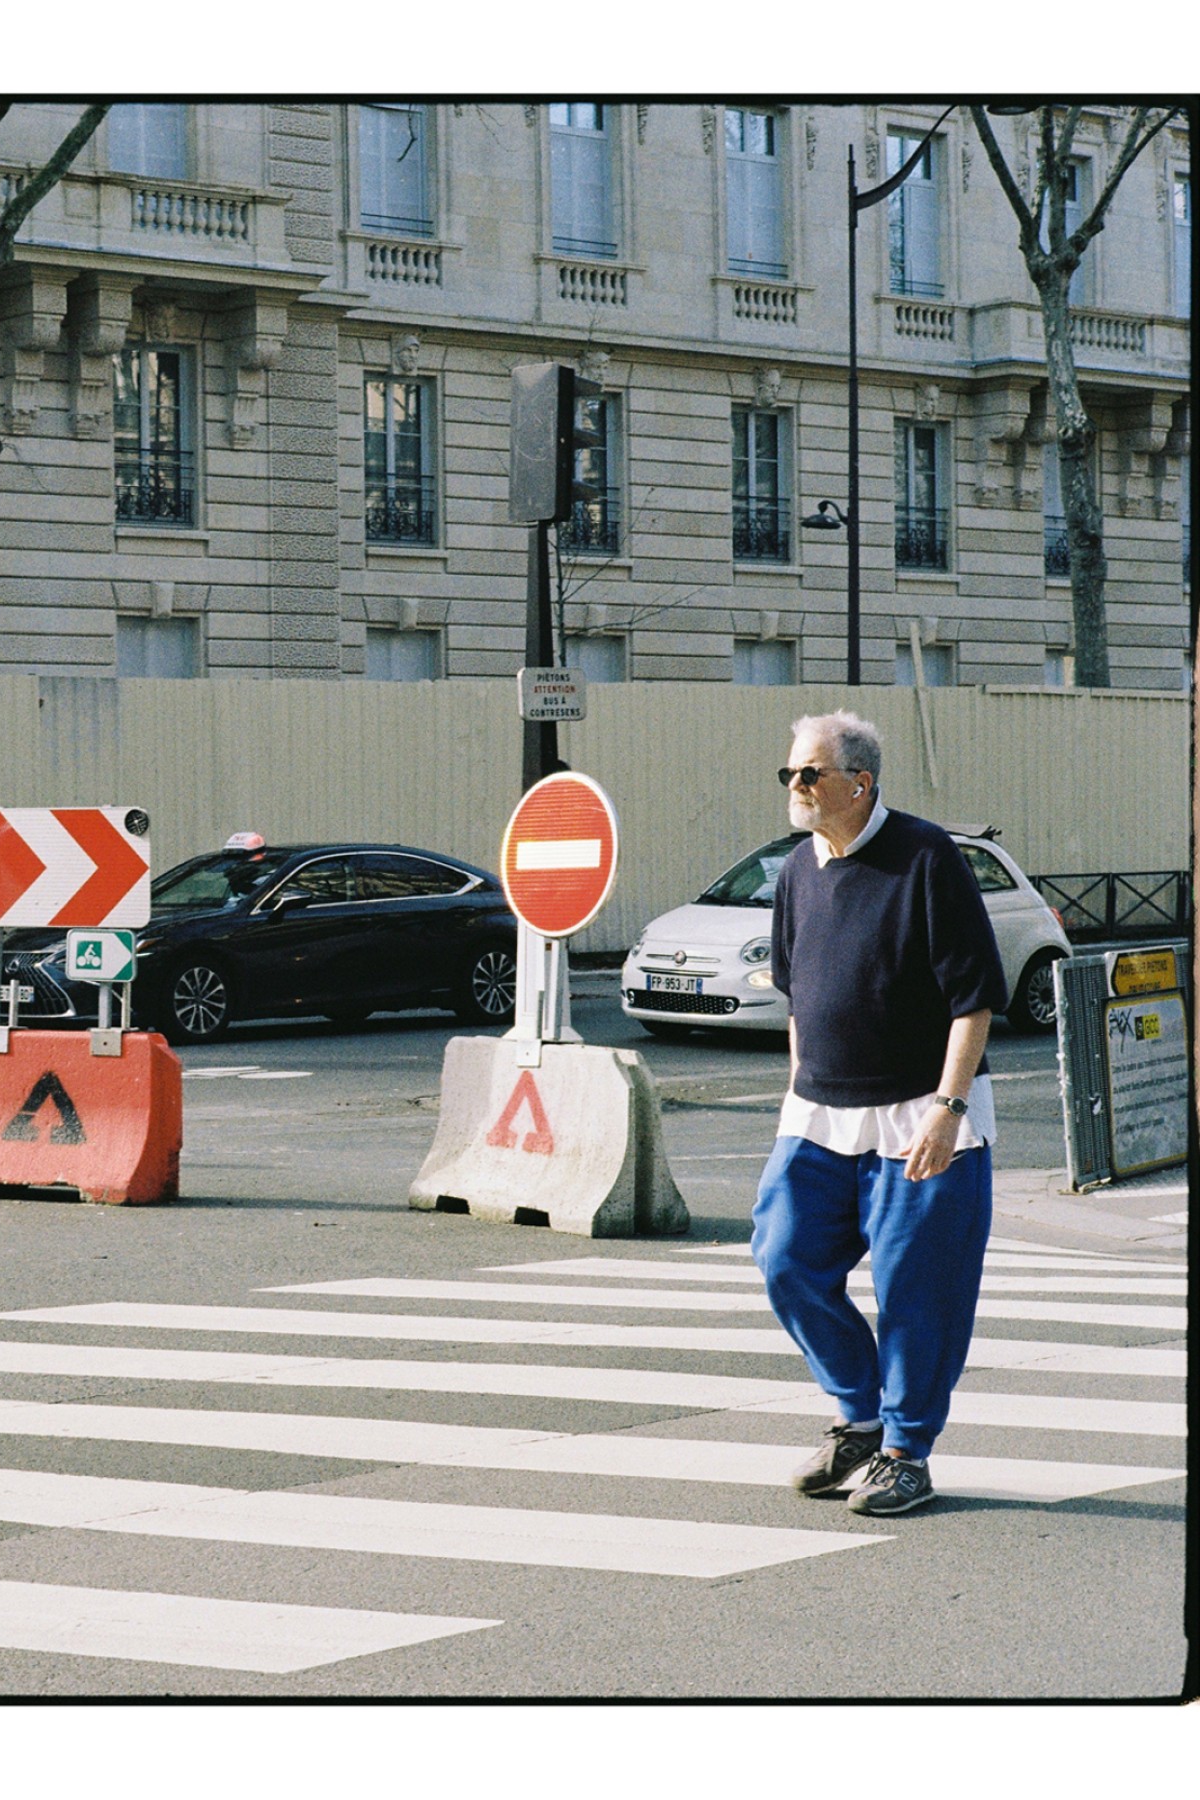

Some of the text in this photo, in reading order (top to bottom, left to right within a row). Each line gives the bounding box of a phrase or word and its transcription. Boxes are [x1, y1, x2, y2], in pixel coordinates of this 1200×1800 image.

[533, 685, 576, 693] ATTENTION
[543, 697, 558, 705] BUS
[530, 708, 580, 717] CONTRESENS
